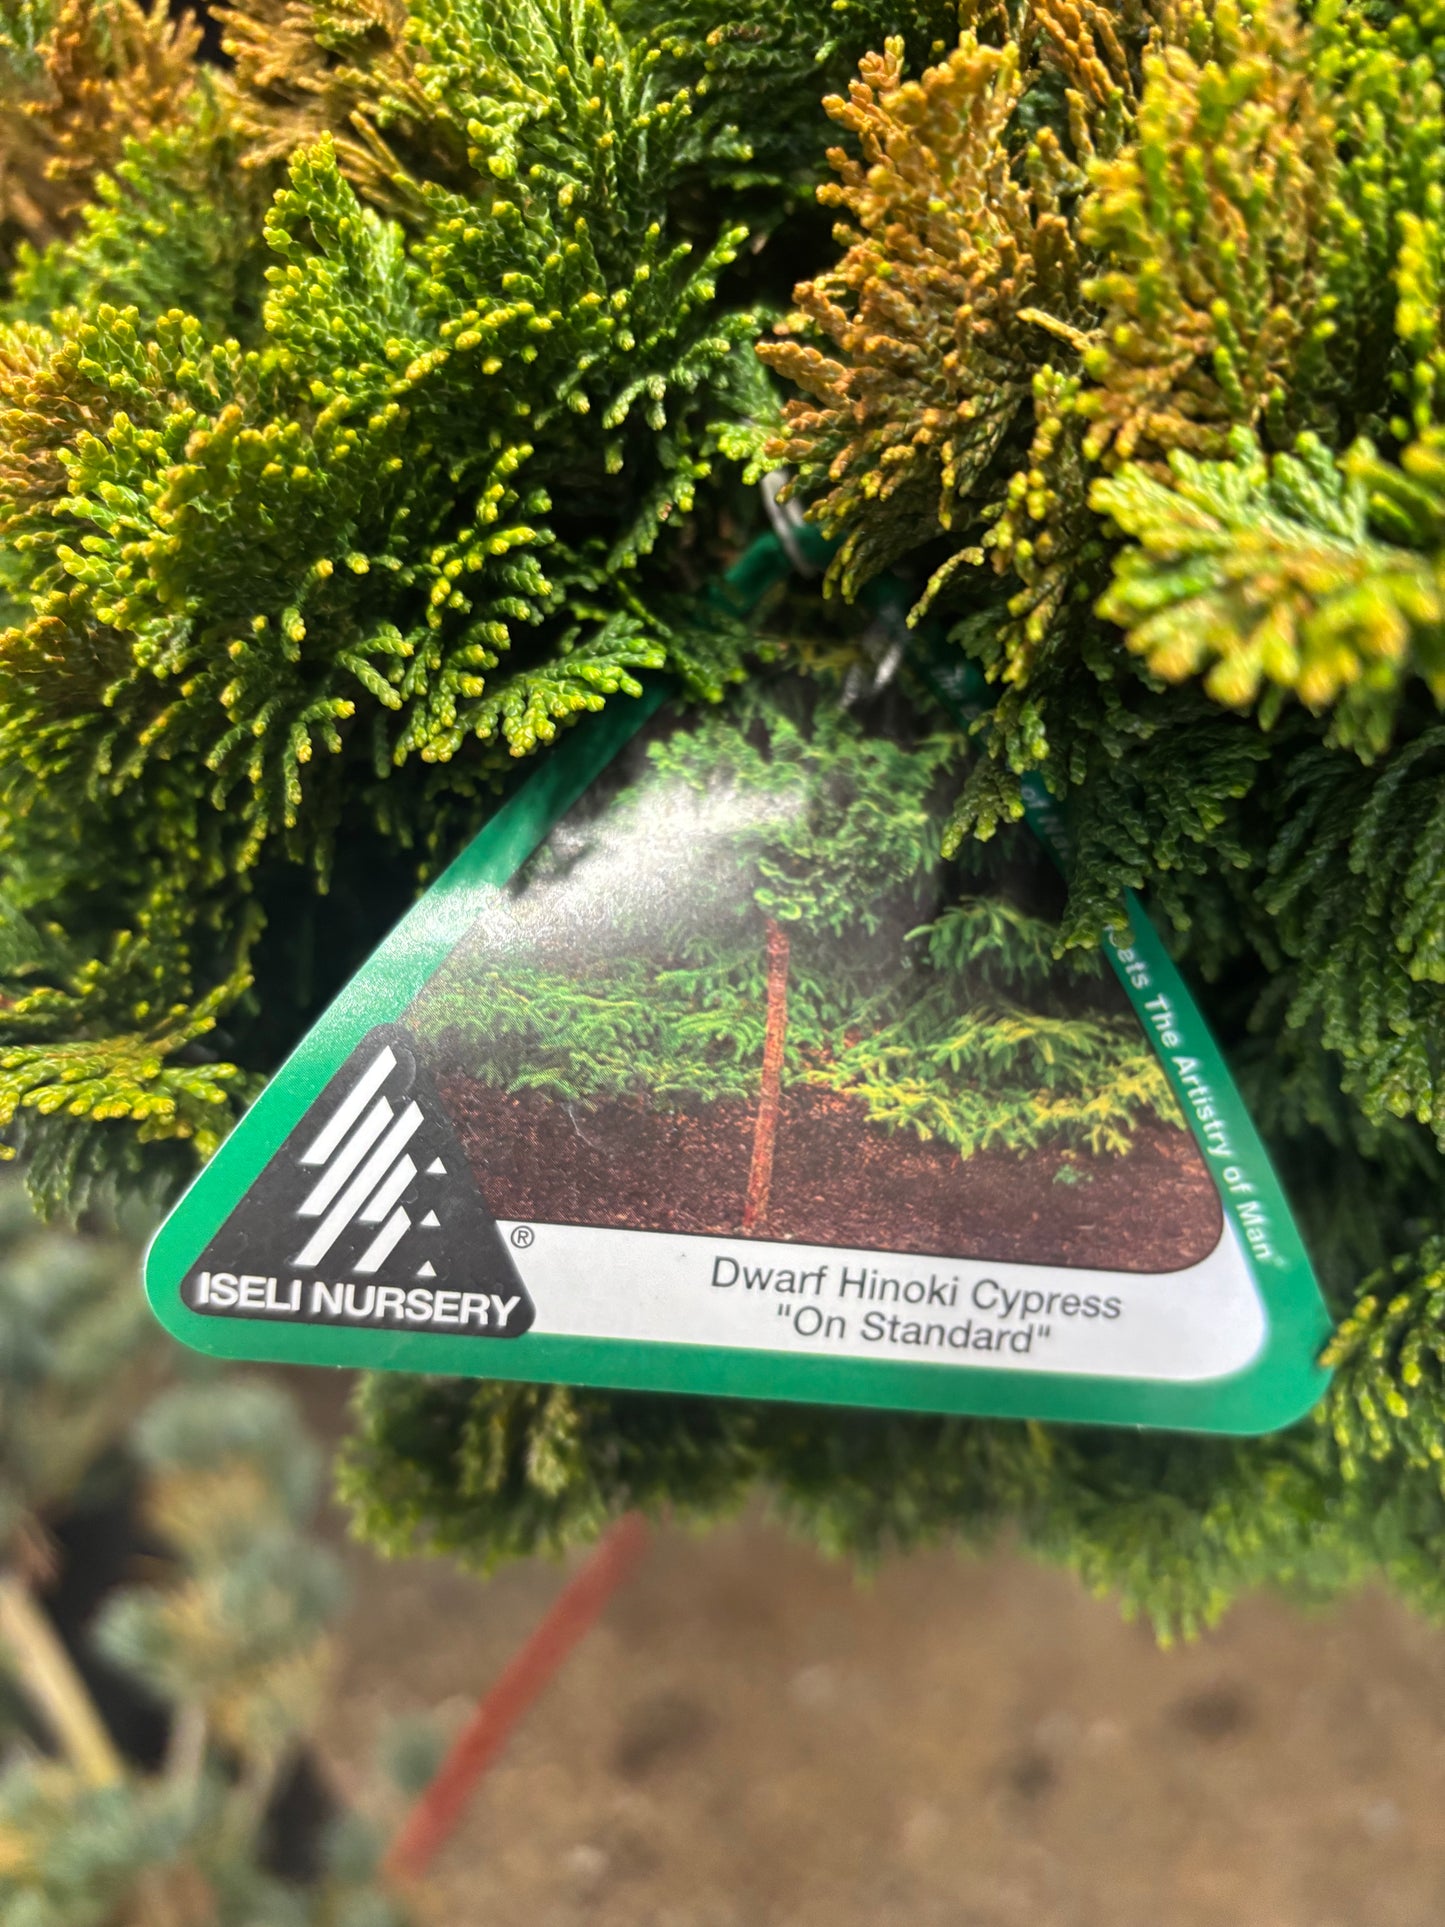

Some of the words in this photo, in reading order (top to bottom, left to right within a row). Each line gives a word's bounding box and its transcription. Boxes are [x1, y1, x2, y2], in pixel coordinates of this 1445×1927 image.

[1144, 993, 1179, 1049] The
[1171, 1056, 1232, 1157] Artistry
[1223, 1166, 1254, 1194] of
[197, 1271, 302, 1312] ISELI
[311, 1281, 521, 1327] NURSERY
[711, 1256, 828, 1296] Dwarf
[838, 1267, 960, 1307] Hinoki
[972, 1279, 1122, 1321] Cypress
[777, 1303, 846, 1340] "On
[860, 1311, 1051, 1354] Standard"
